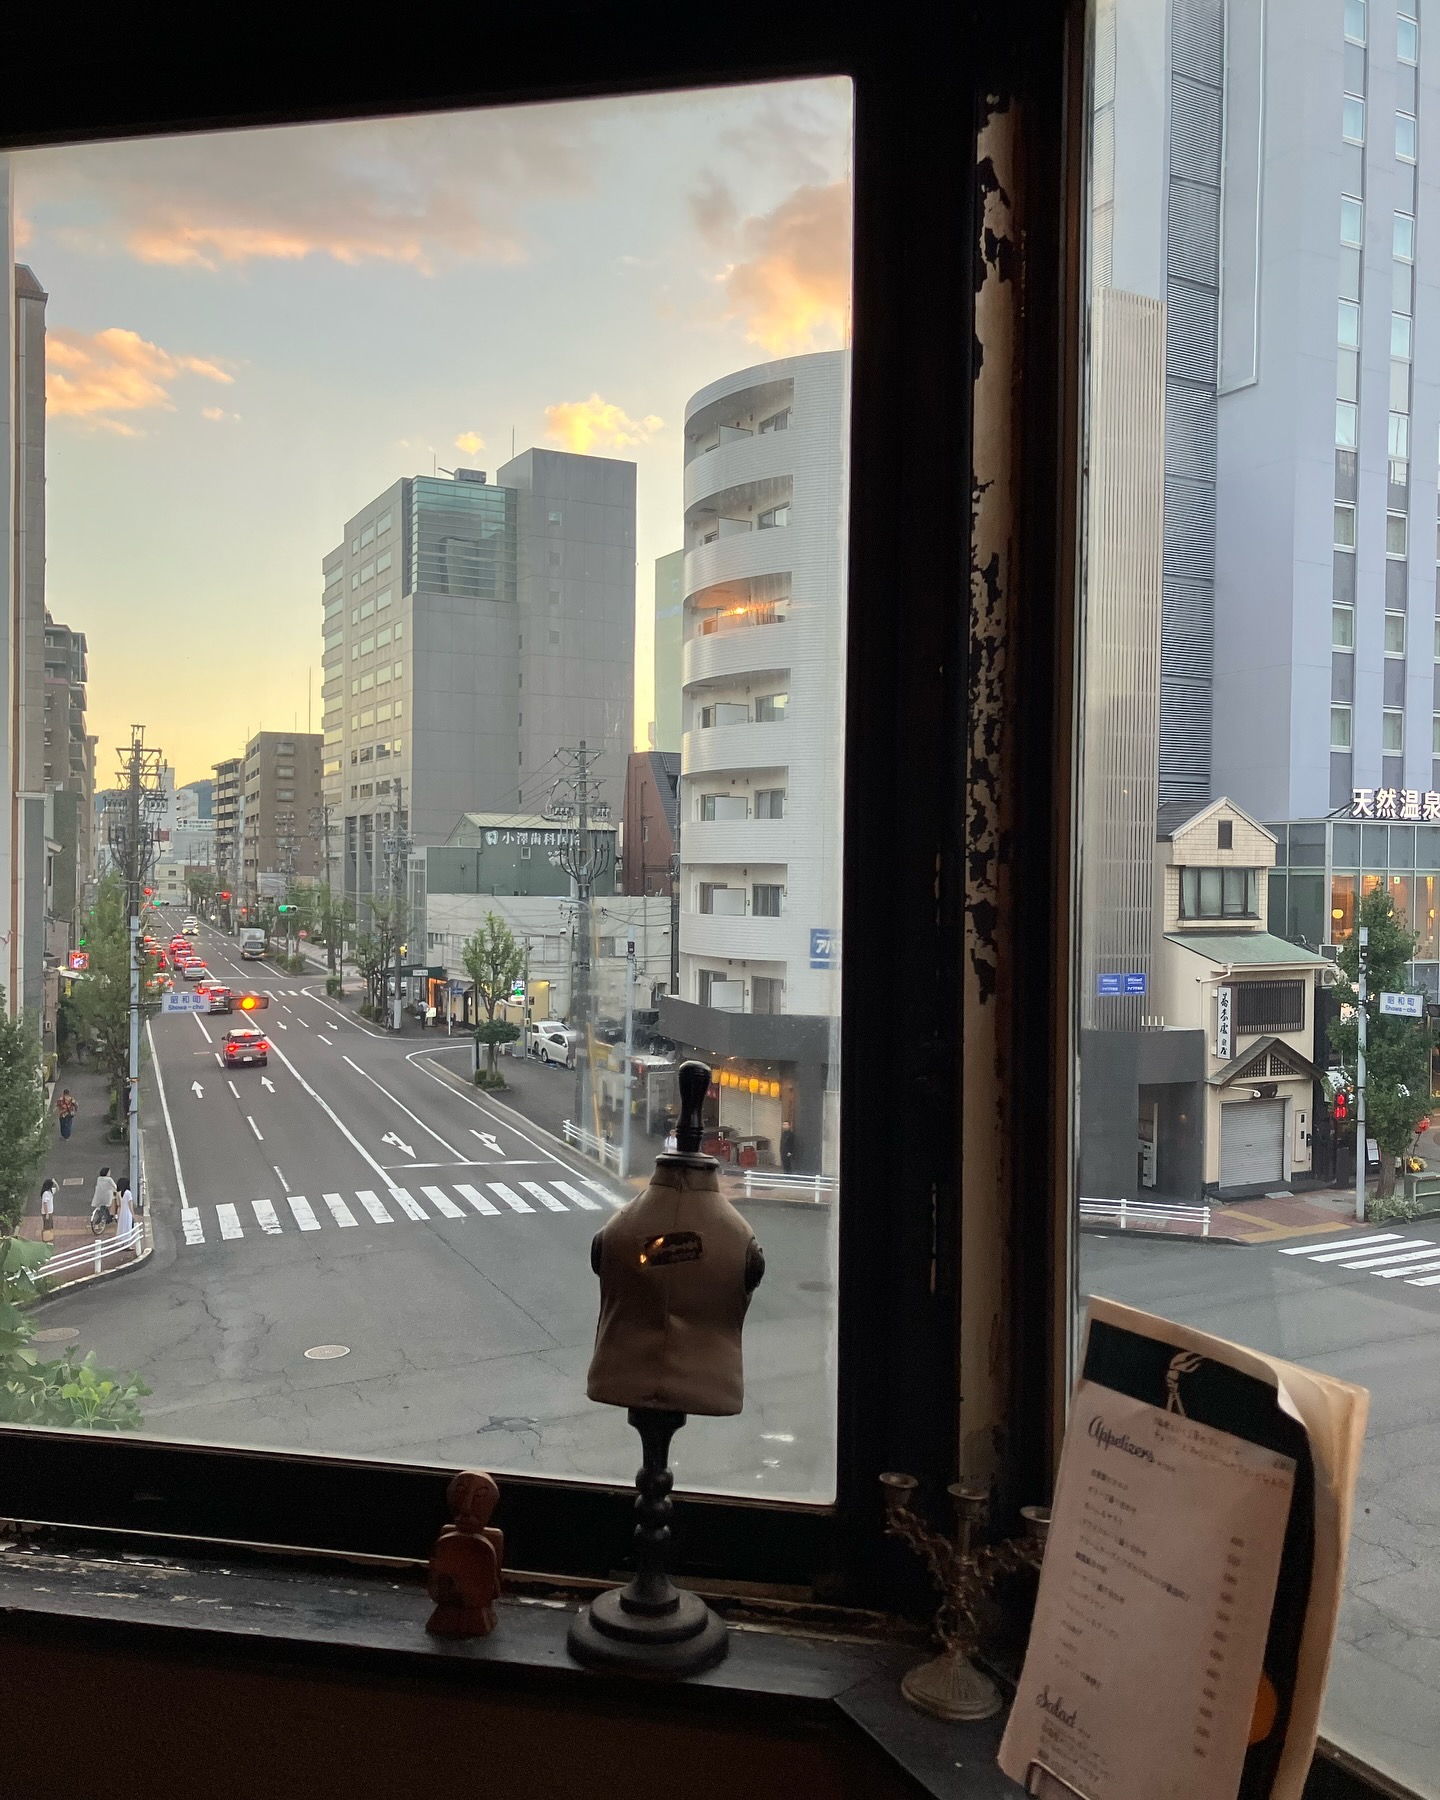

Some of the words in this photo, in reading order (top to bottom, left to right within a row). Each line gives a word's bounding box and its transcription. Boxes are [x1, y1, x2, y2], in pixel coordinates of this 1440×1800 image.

[1352, 788, 1440, 820] 天然温泉
[170, 995, 201, 1004] 昭和町
[1387, 995, 1415, 1006] 昭和町
[1035, 1685, 1078, 1729] Salad
